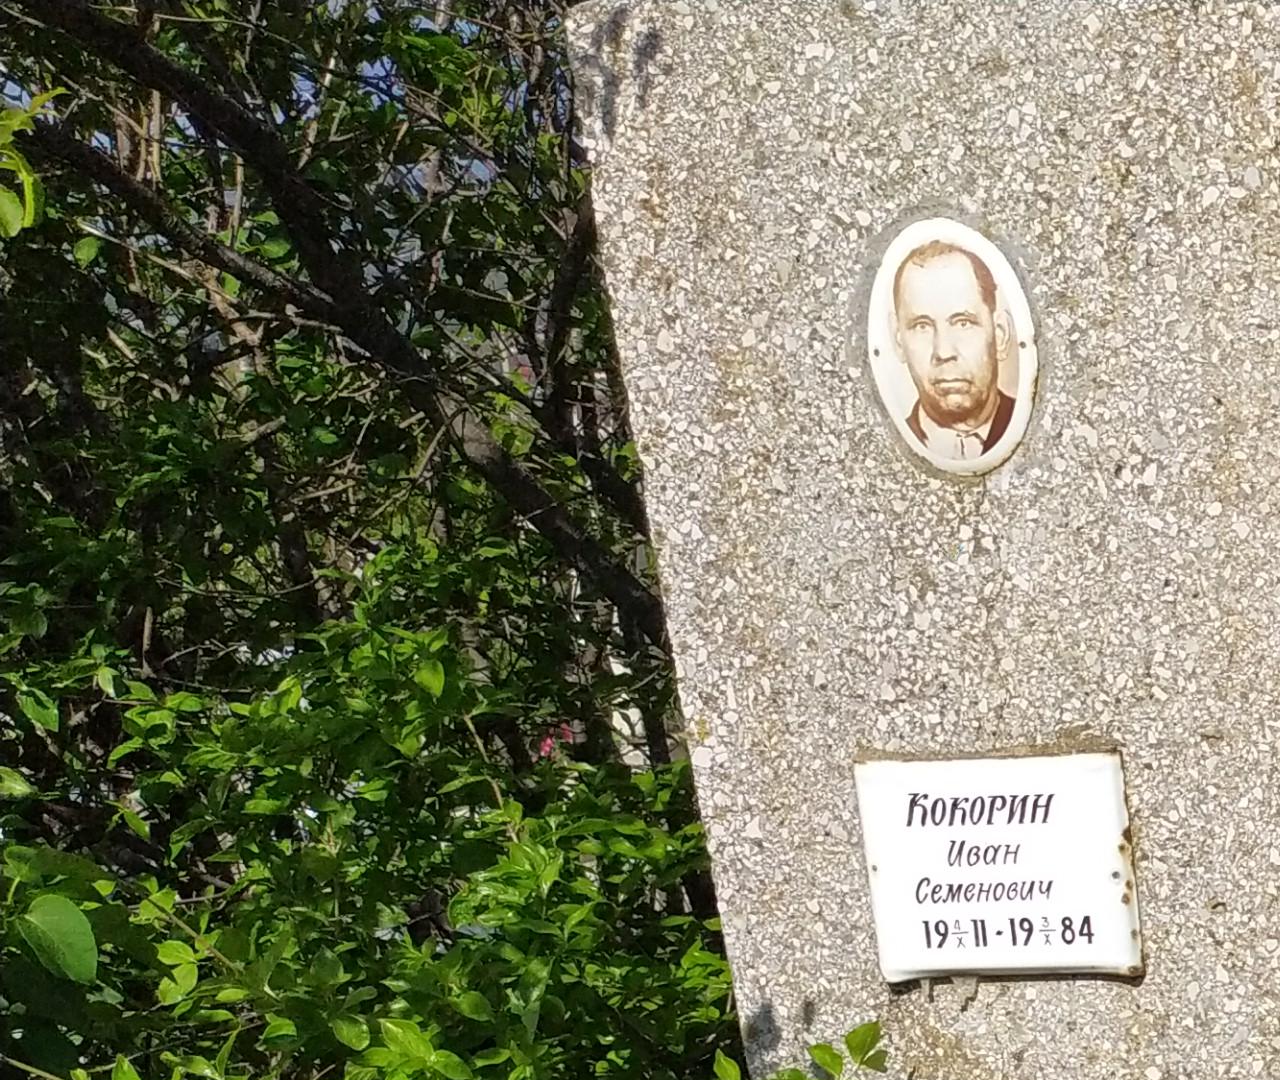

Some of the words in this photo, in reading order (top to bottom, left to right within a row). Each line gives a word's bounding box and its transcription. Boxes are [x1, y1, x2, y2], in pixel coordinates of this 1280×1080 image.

[906, 792, 1055, 828] КОКОРИН
[946, 840, 1021, 868] Иван
[915, 876, 1054, 905] Семенович
